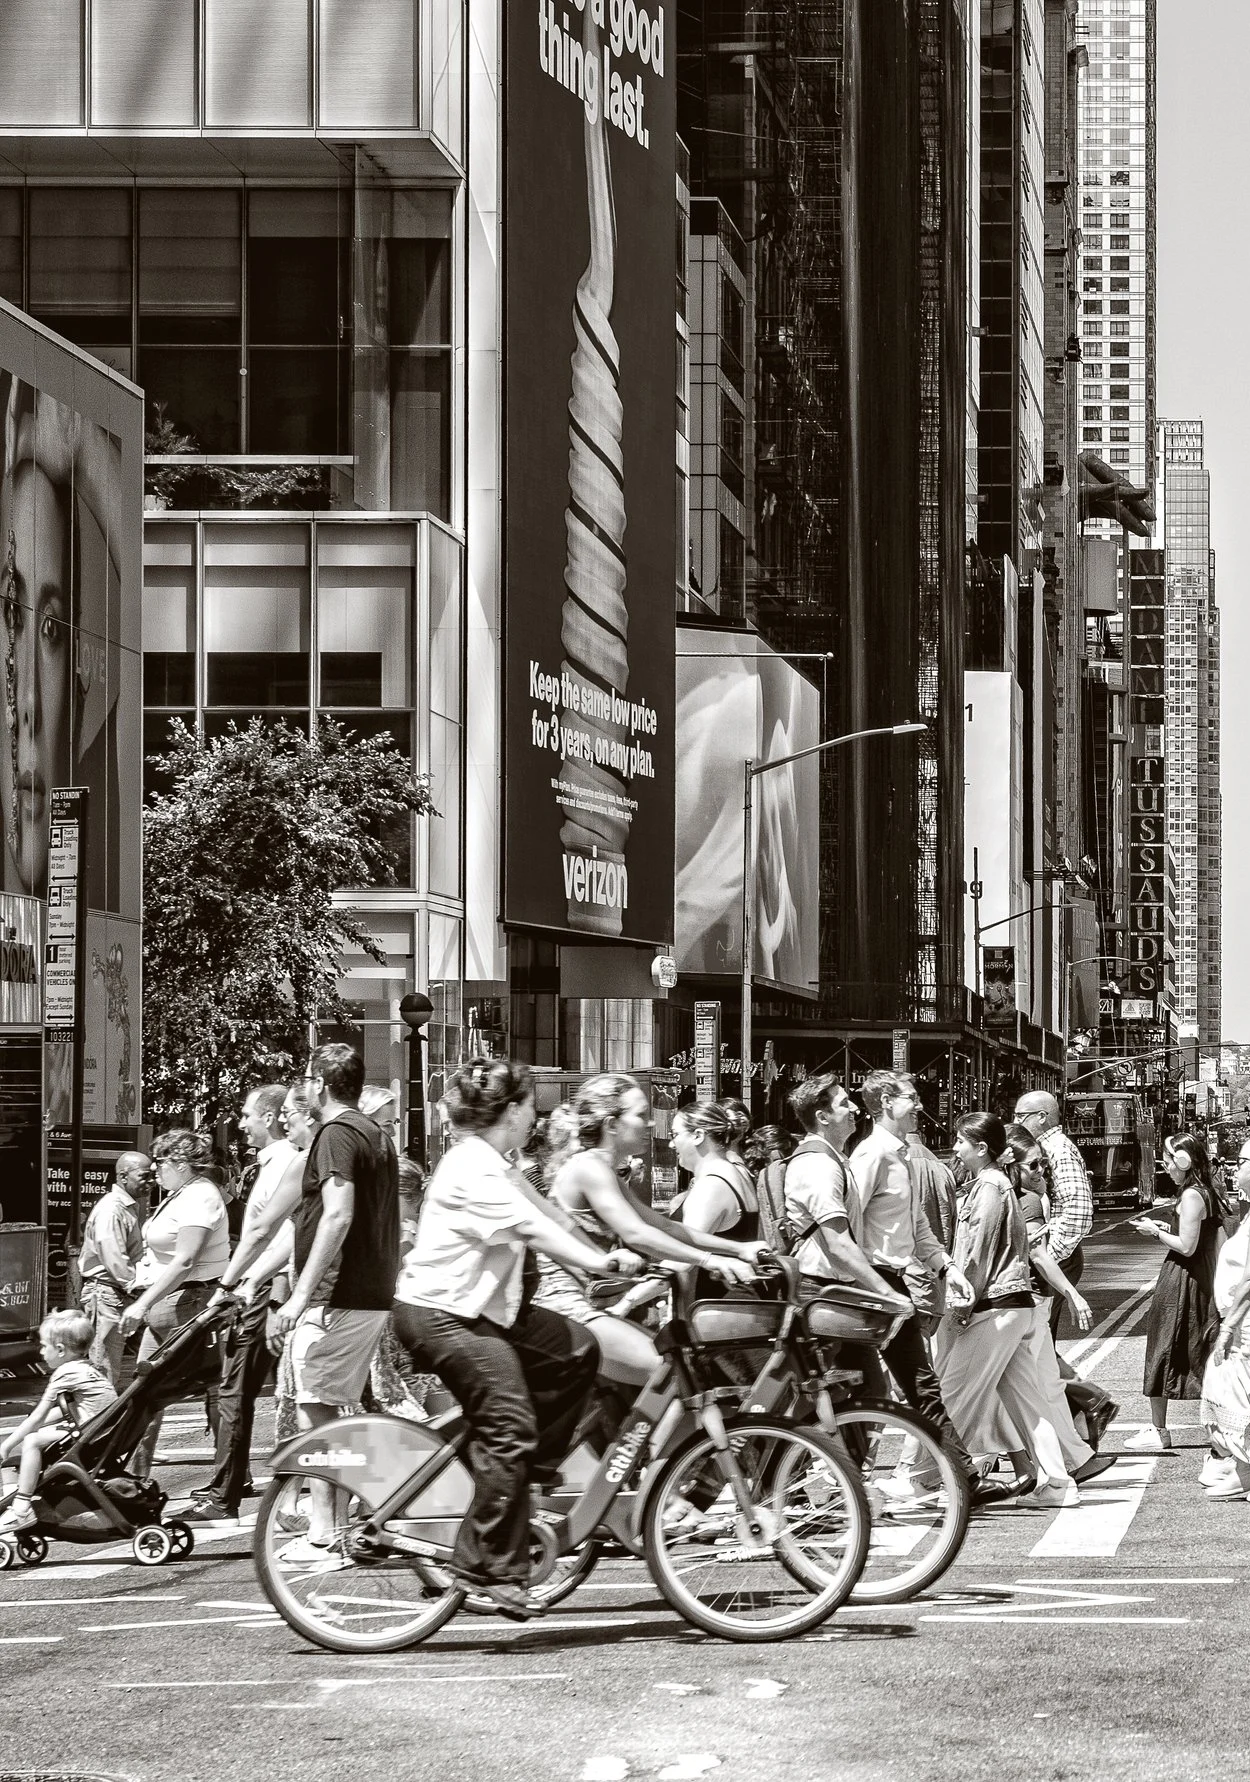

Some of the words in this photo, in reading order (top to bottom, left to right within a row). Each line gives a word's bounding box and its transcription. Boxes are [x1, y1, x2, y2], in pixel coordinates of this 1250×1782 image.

[609, 0, 663, 77] good
[539, 0, 599, 125] thing
[604, 45, 649, 149] last.
[530, 660, 560, 712] Keep
[561, 672, 580, 711] the
[580, 686, 611, 721] same
[612, 687, 630, 727] low
[631, 697, 657, 735] price
[532, 709, 549, 749] for
[550, 714, 559, 751] 3
[560, 726, 594, 768] years,
[595, 737, 609, 766] on
[610, 741, 629, 777] any
[630, 740, 655, 779] plan.
[60, 791, 82, 799] STANDIN
[562, 845, 628, 909] verizon
[1137, 758, 1158, 991] TUSSAUDS
[47, 978, 68, 986] VEHICLES
[50, 946, 54, 962] 1
[50, 1031, 74, 1042] 103221
[47, 1168, 70, 1179] Take
[84, 1170, 108, 1183] easy
